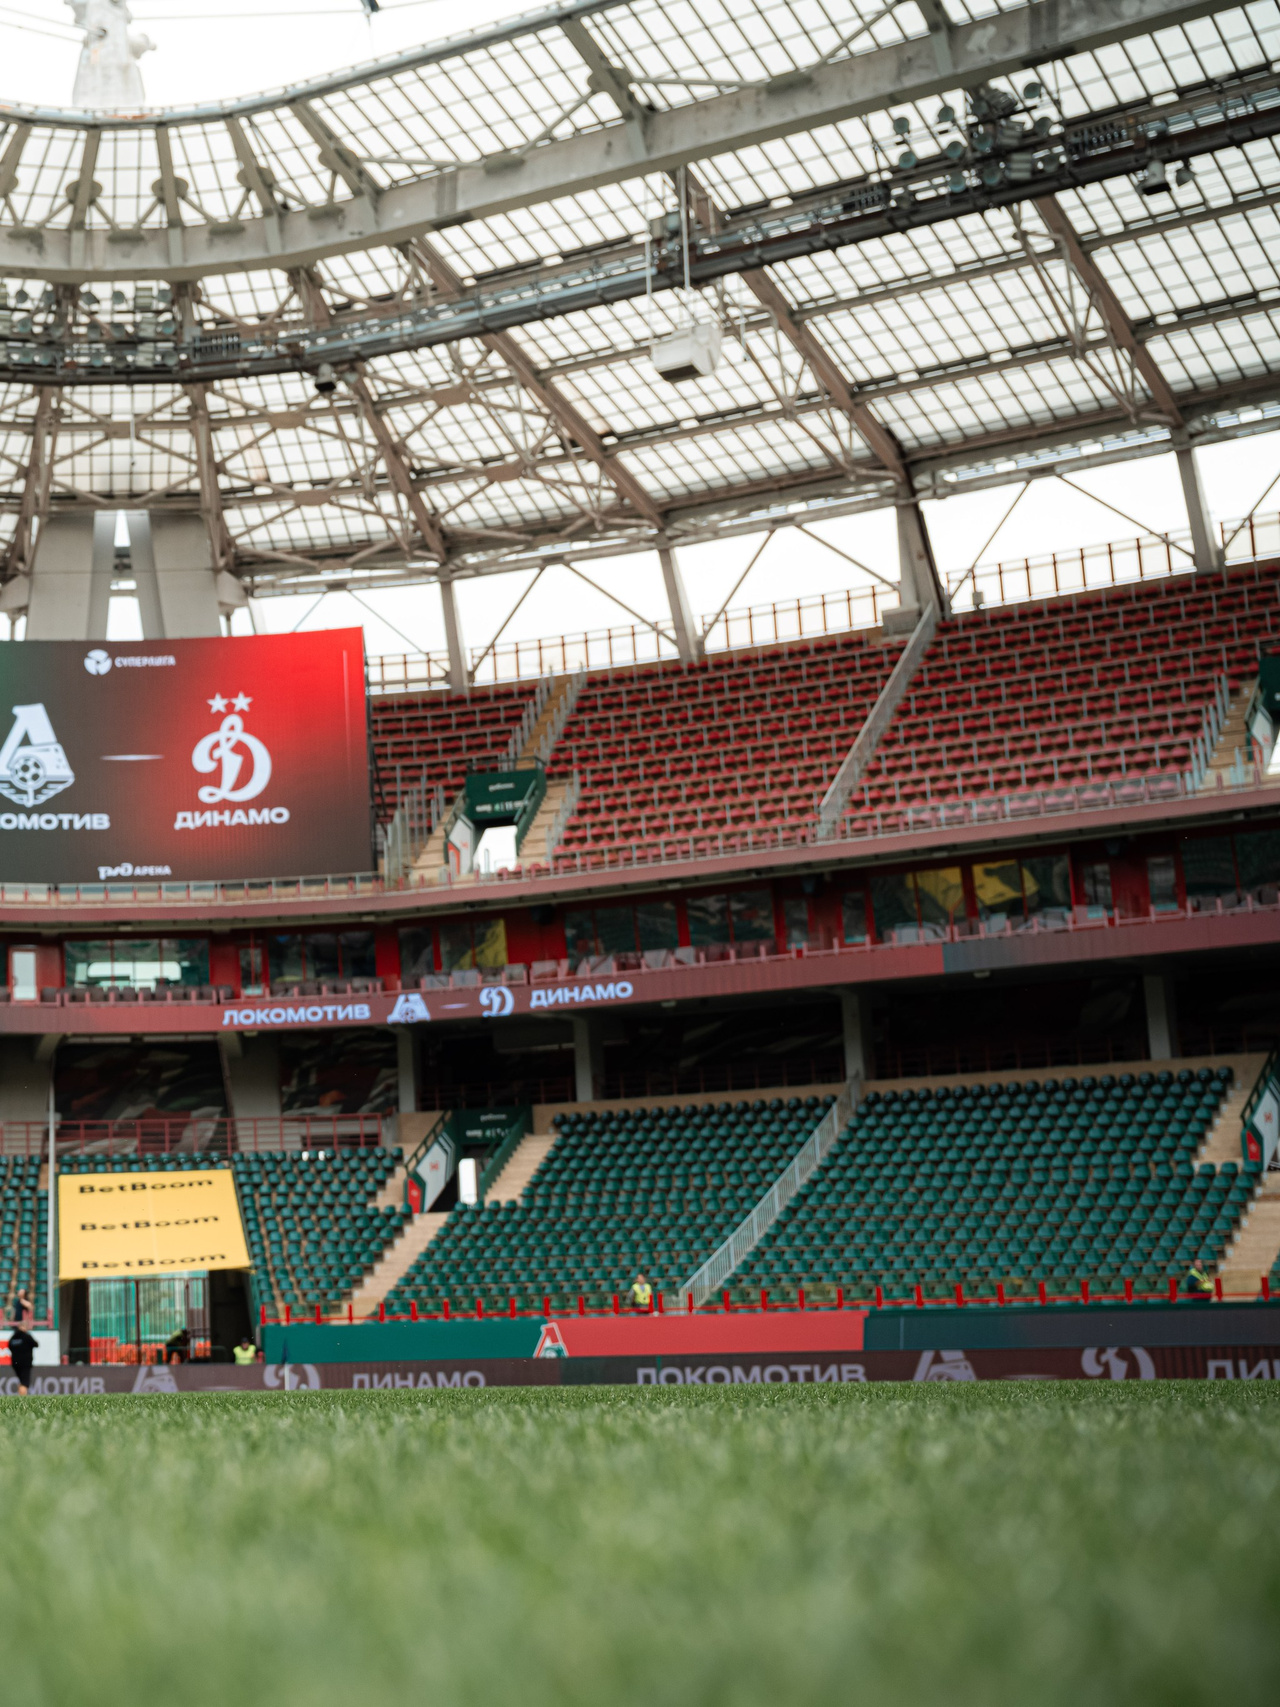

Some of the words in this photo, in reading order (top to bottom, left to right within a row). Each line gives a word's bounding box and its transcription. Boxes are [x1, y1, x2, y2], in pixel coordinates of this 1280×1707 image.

[114, 655, 177, 668] СУПЕРЛИГА
[174, 806, 290, 830] ДИНАМО
[133, 864, 172, 876] АРЕНА
[530, 981, 634, 1008] ДИНАМО
[222, 1003, 371, 1026] ЛОКОМОТИВ
[78, 1179, 213, 1194] BetBoom
[80, 1214, 219, 1231] BetBoom
[81, 1253, 227, 1269] BetBoom
